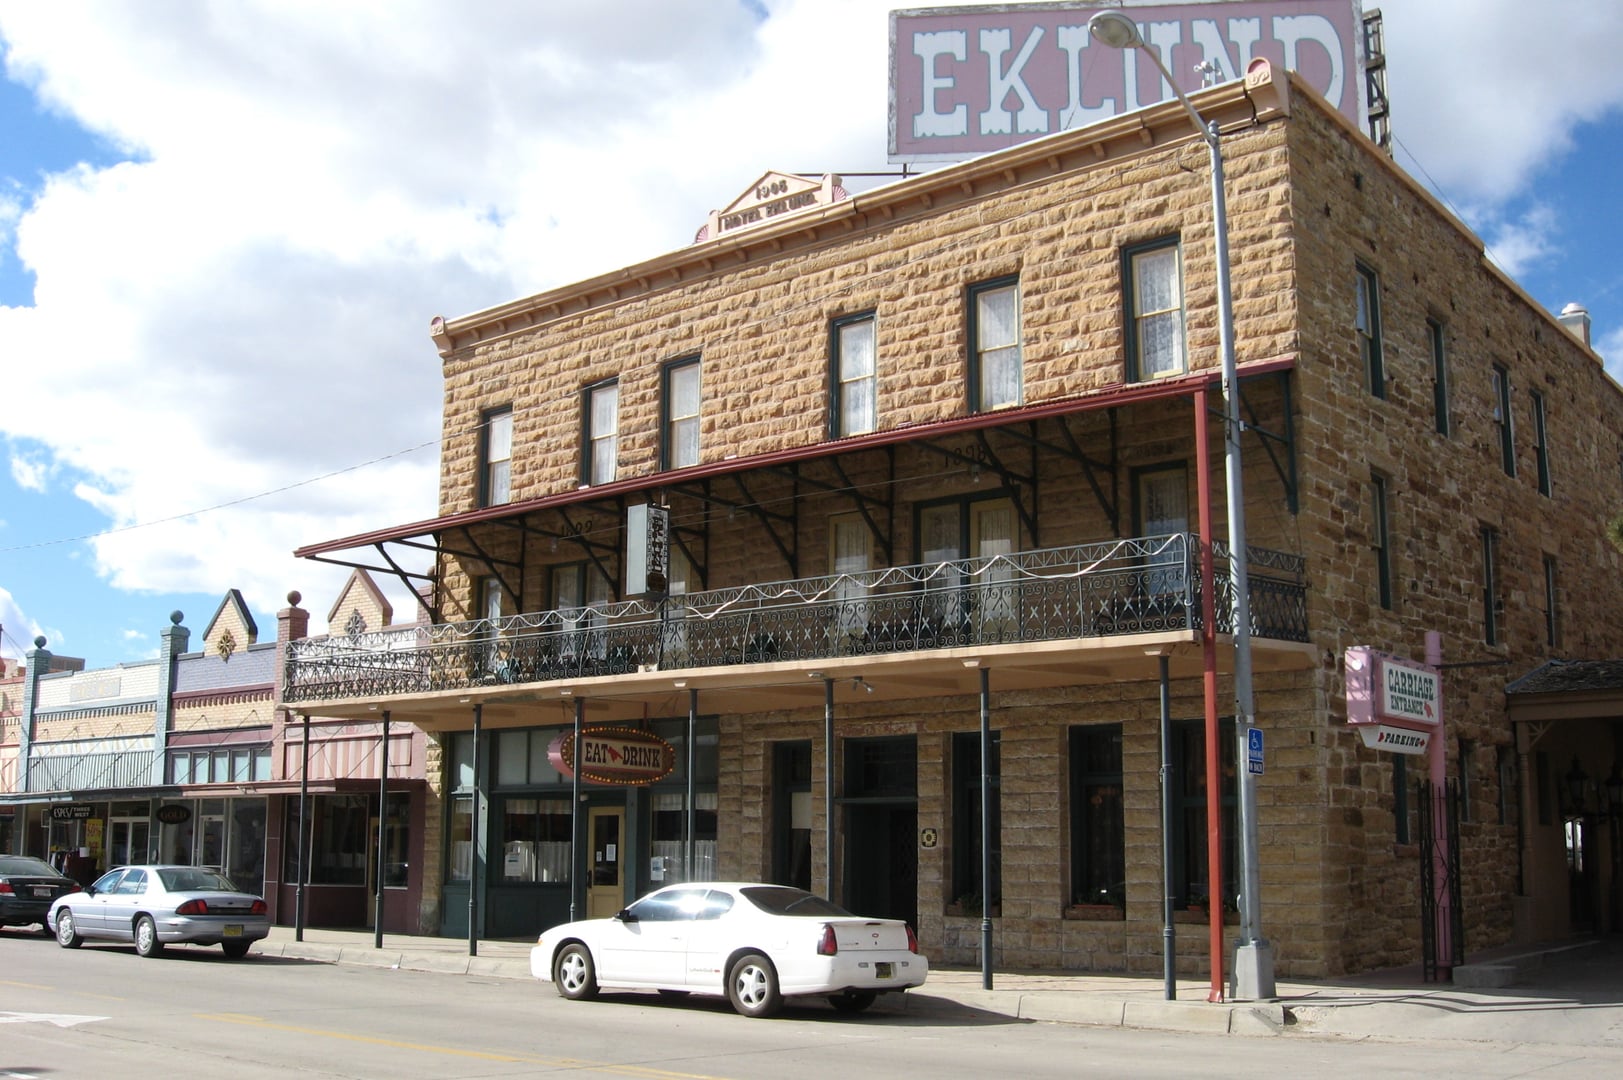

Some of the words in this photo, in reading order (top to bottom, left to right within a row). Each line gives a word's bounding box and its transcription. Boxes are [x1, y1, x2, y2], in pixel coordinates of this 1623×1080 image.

[912, 14, 1346, 138] EKLUND
[724, 207, 762, 230] HOTEL
[766, 192, 817, 217] EKLUND
[1388, 669, 1434, 701] CARRIAGE
[1390, 694, 1424, 715] ENTRANCE
[1384, 733, 1420, 747] PARKING
[585, 742, 608, 763] EAT
[622, 745, 661, 768] DRINK
